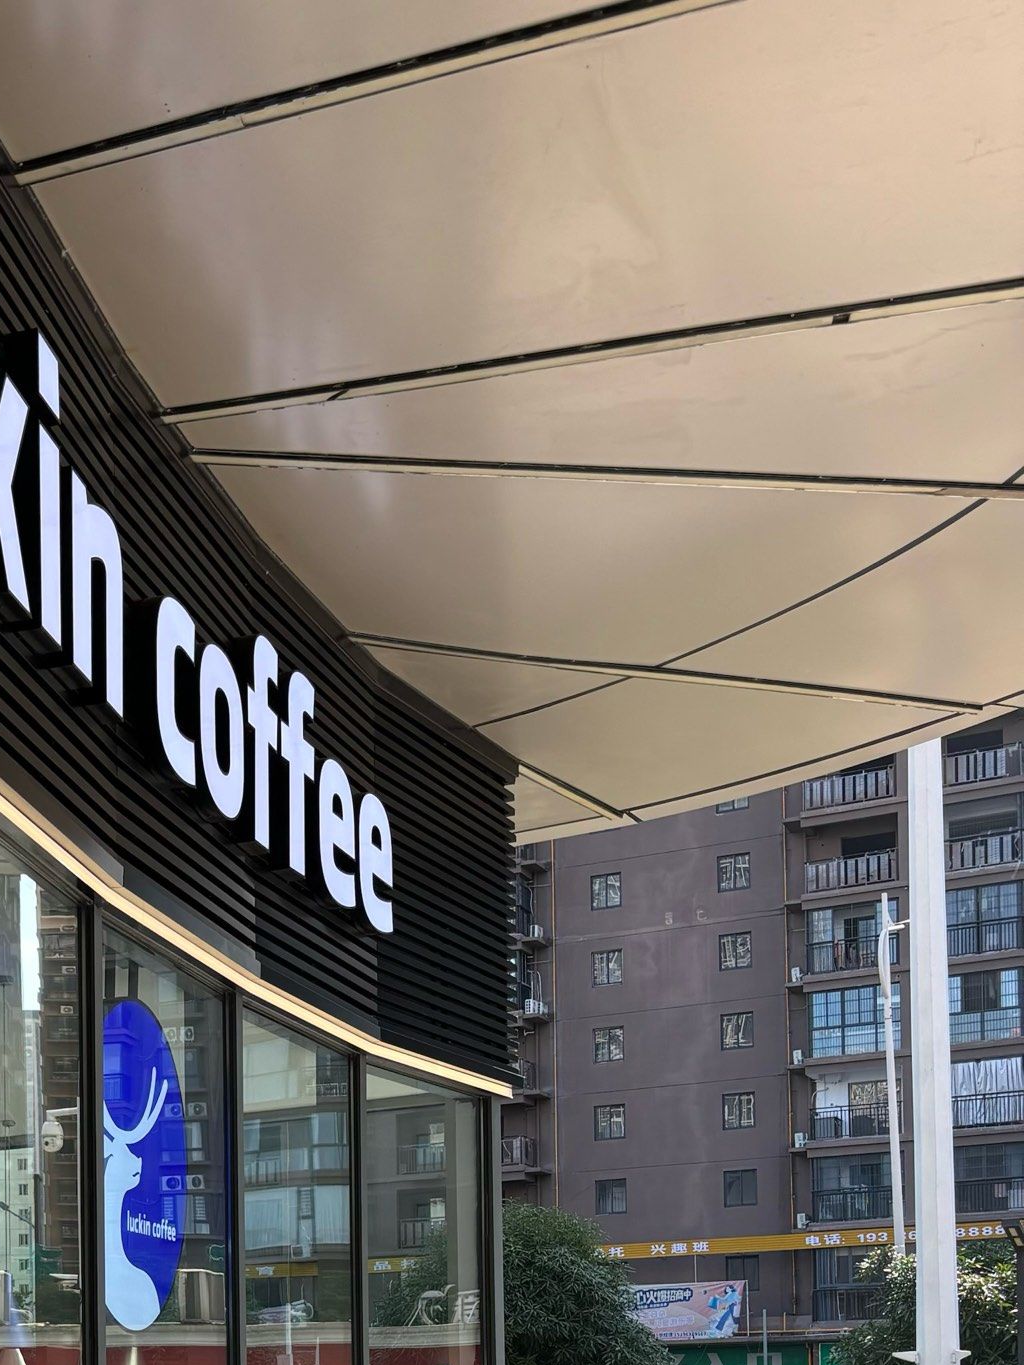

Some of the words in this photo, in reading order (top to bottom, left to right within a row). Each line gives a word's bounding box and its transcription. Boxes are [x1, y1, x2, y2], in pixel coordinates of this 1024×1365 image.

[156, 597, 394, 933] coffee
[127, 1210, 150, 1236] luckin
[152, 1218, 176, 1242] coffee
[650, 1241, 710, 1255] 兴趣班
